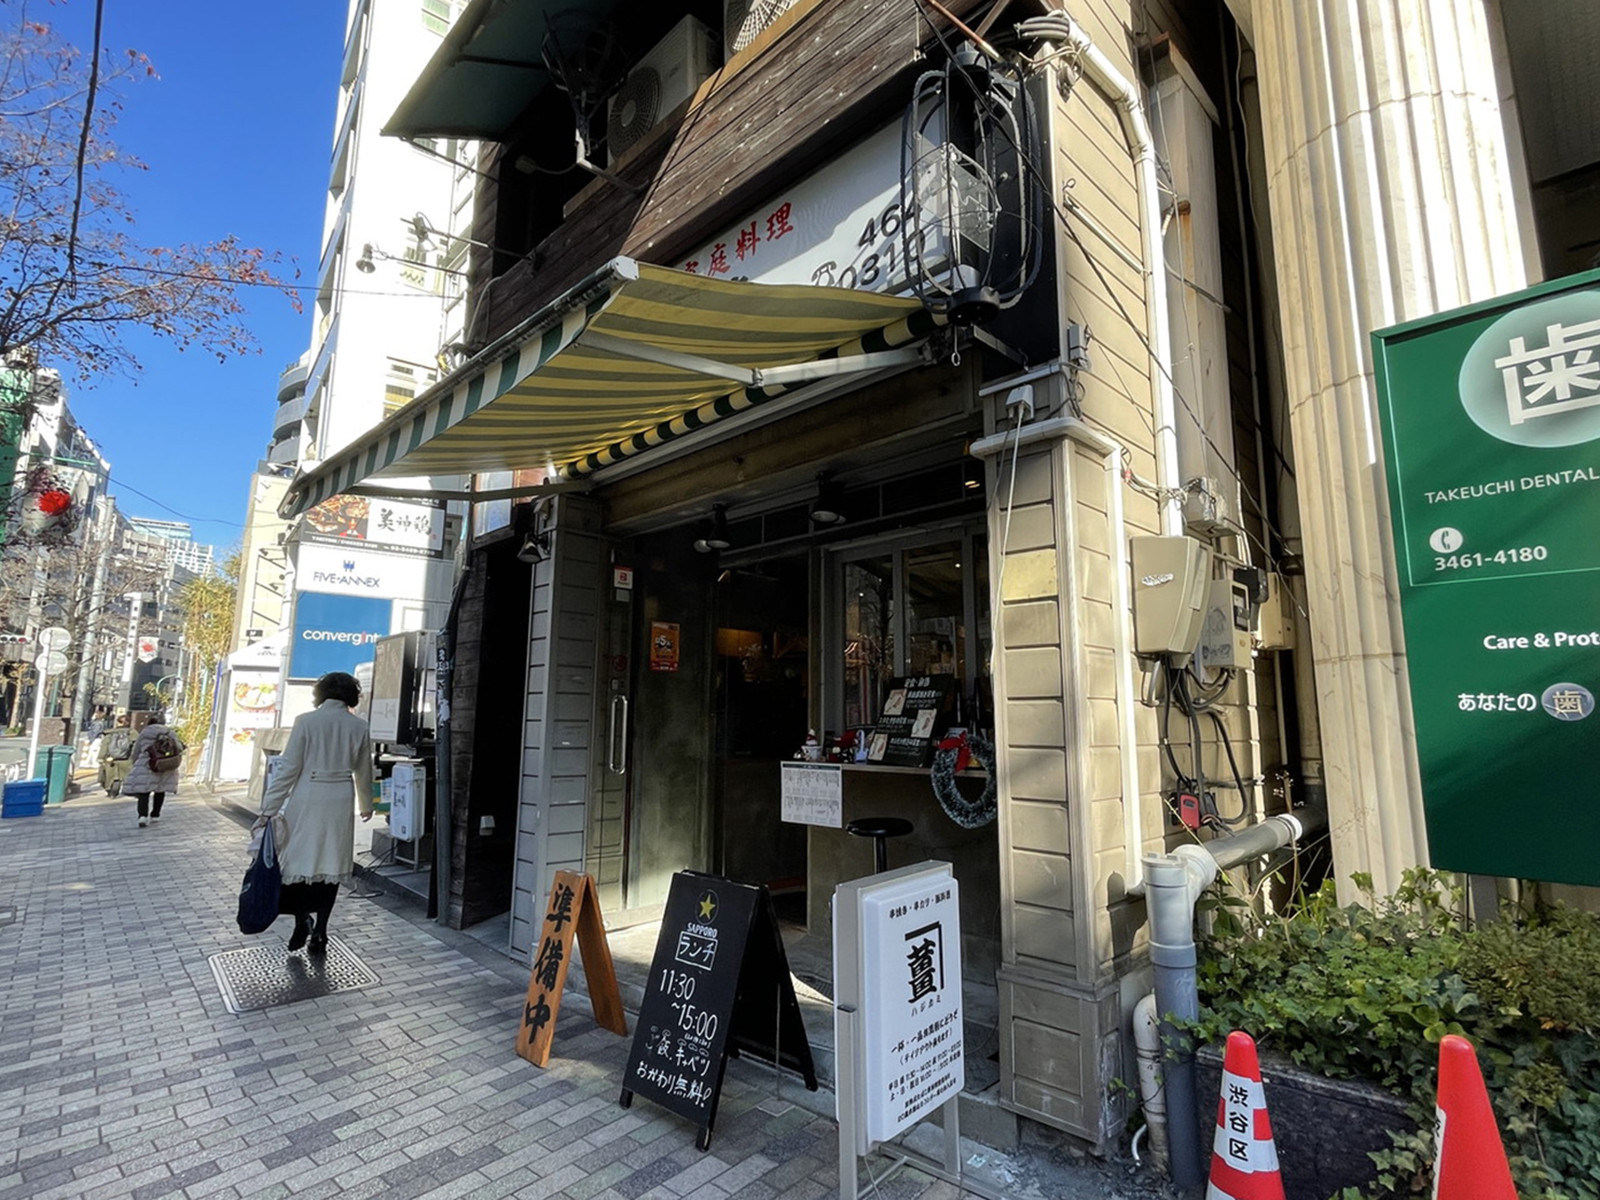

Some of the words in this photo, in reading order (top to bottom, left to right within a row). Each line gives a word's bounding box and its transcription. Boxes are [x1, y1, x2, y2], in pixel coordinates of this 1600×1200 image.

[1494, 319, 1600, 426] 歯
[1424, 480, 1515, 504] TAKEUCHI
[1520, 467, 1600, 490] DENTAL
[1434, 545, 1548, 571] 3461-4180
[1483, 635, 1529, 650] Care
[1534, 632, 1550, 648] &
[1554, 631, 1600, 647] Prot
[1458, 692, 1537, 711] あなたの
[1552, 690, 1585, 717] 歯
[687, 922, 718, 939] SAPPORO
[525, 882, 575, 1044] 準備中
[680, 936, 714, 962] ランチ
[659, 969, 696, 1000] 11:30
[1228, 1083, 1249, 1162] 渋谷区
